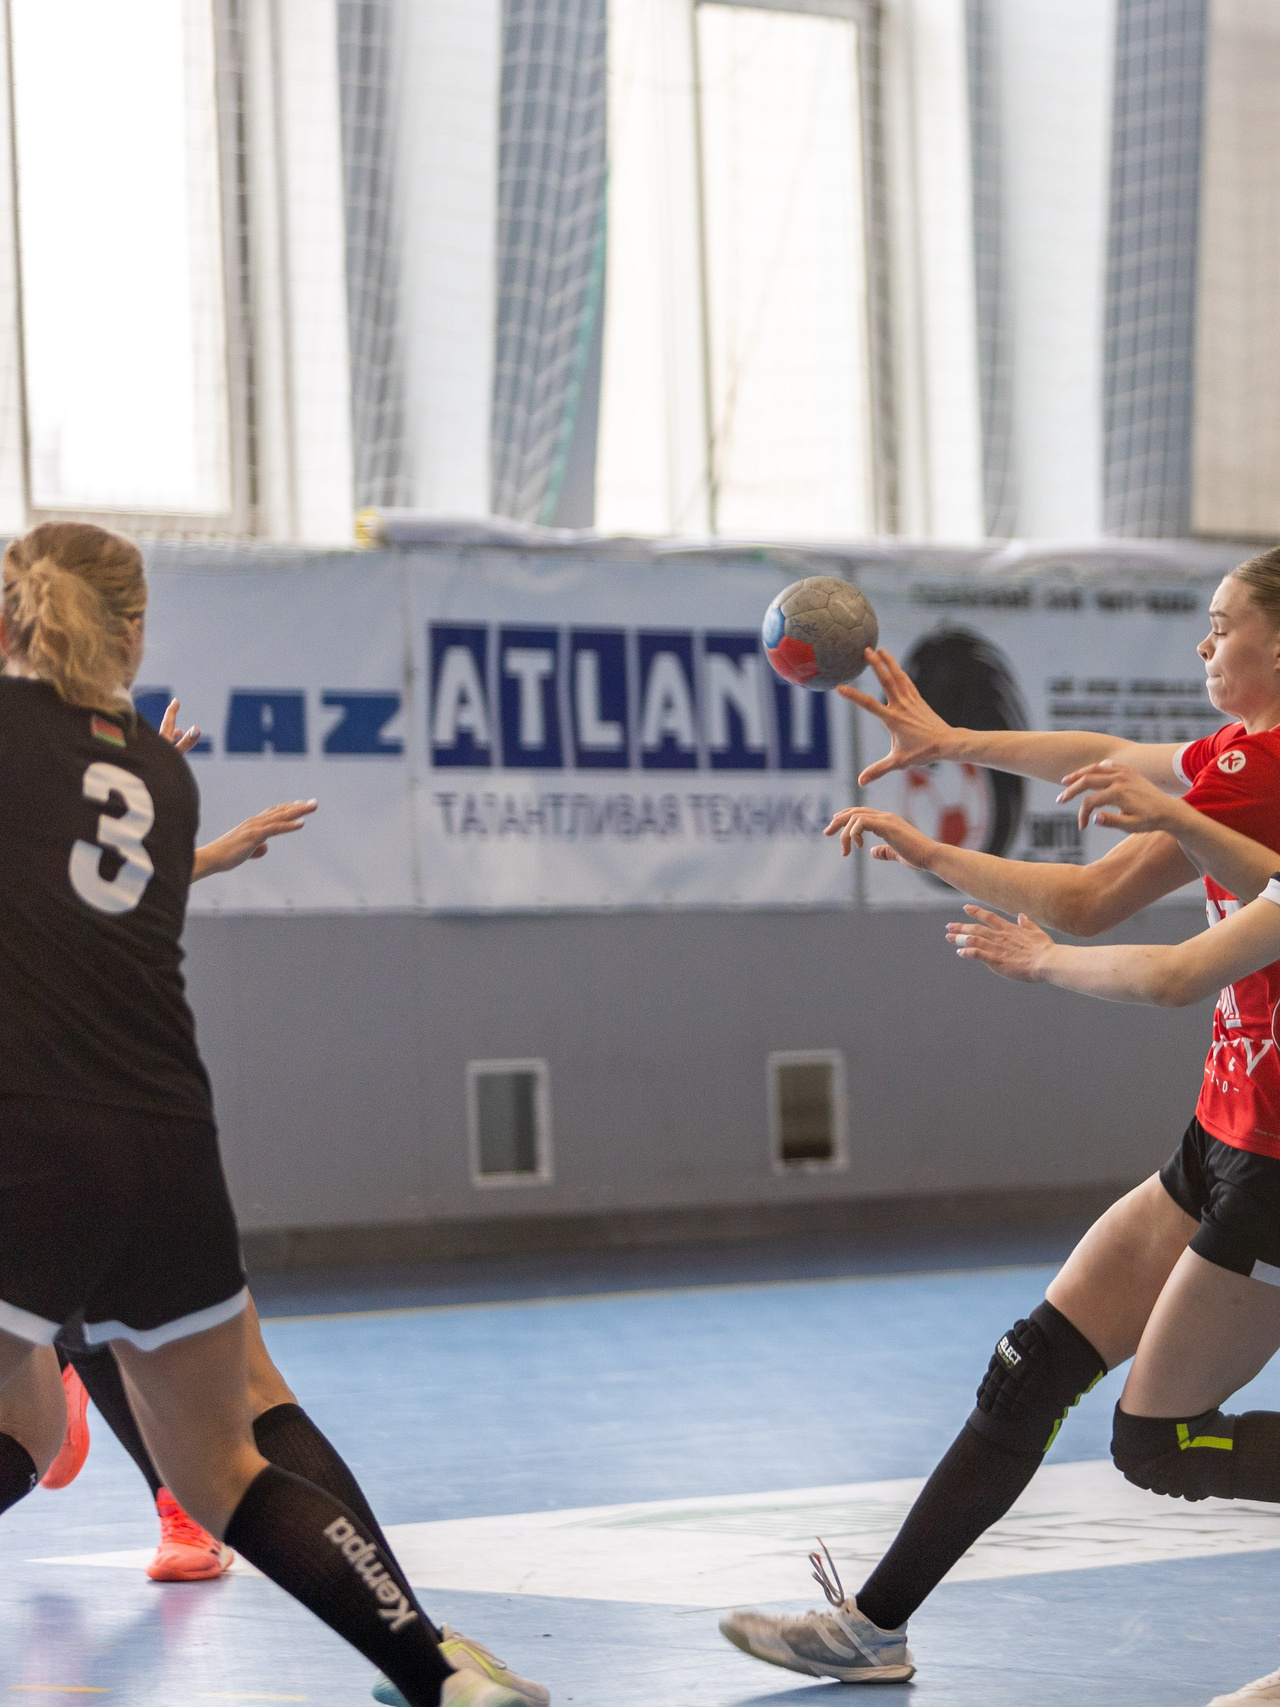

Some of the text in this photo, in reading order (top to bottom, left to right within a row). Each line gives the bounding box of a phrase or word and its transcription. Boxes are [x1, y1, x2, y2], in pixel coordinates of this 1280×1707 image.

[69, 762, 155, 914] 3
[999, 1336, 1022, 1366] SELECT
[322, 1516, 418, 1632] Kempa
